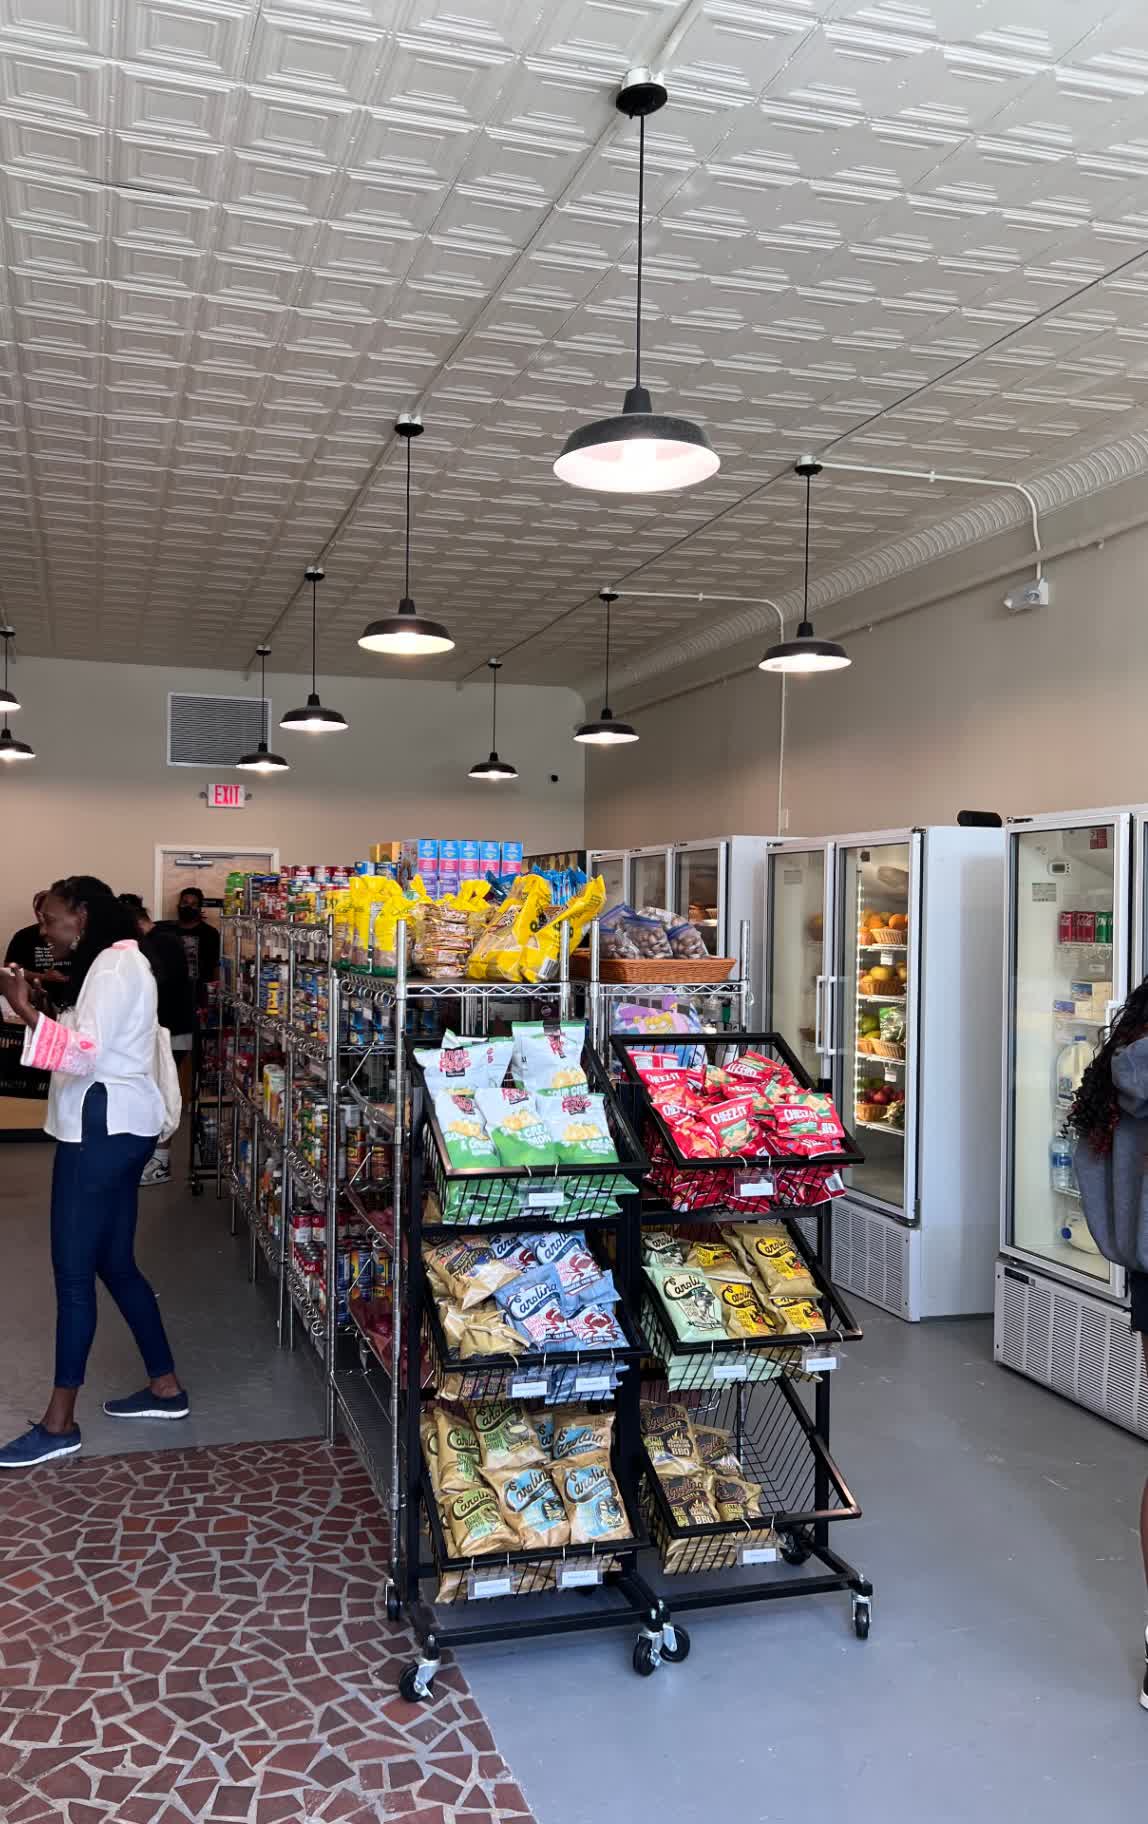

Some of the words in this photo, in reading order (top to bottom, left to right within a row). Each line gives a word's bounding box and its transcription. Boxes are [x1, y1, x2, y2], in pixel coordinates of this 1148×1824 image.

[215, 784, 241, 807] EXIT
[645, 1071, 680, 1084] CHEEZ-IT
[710, 1104, 748, 1125] CHEEZ-IT
[509, 1283, 558, 1317] Carolina
[671, 1448, 691, 1457] BBQ
[694, 1514, 715, 1525] BBQ
